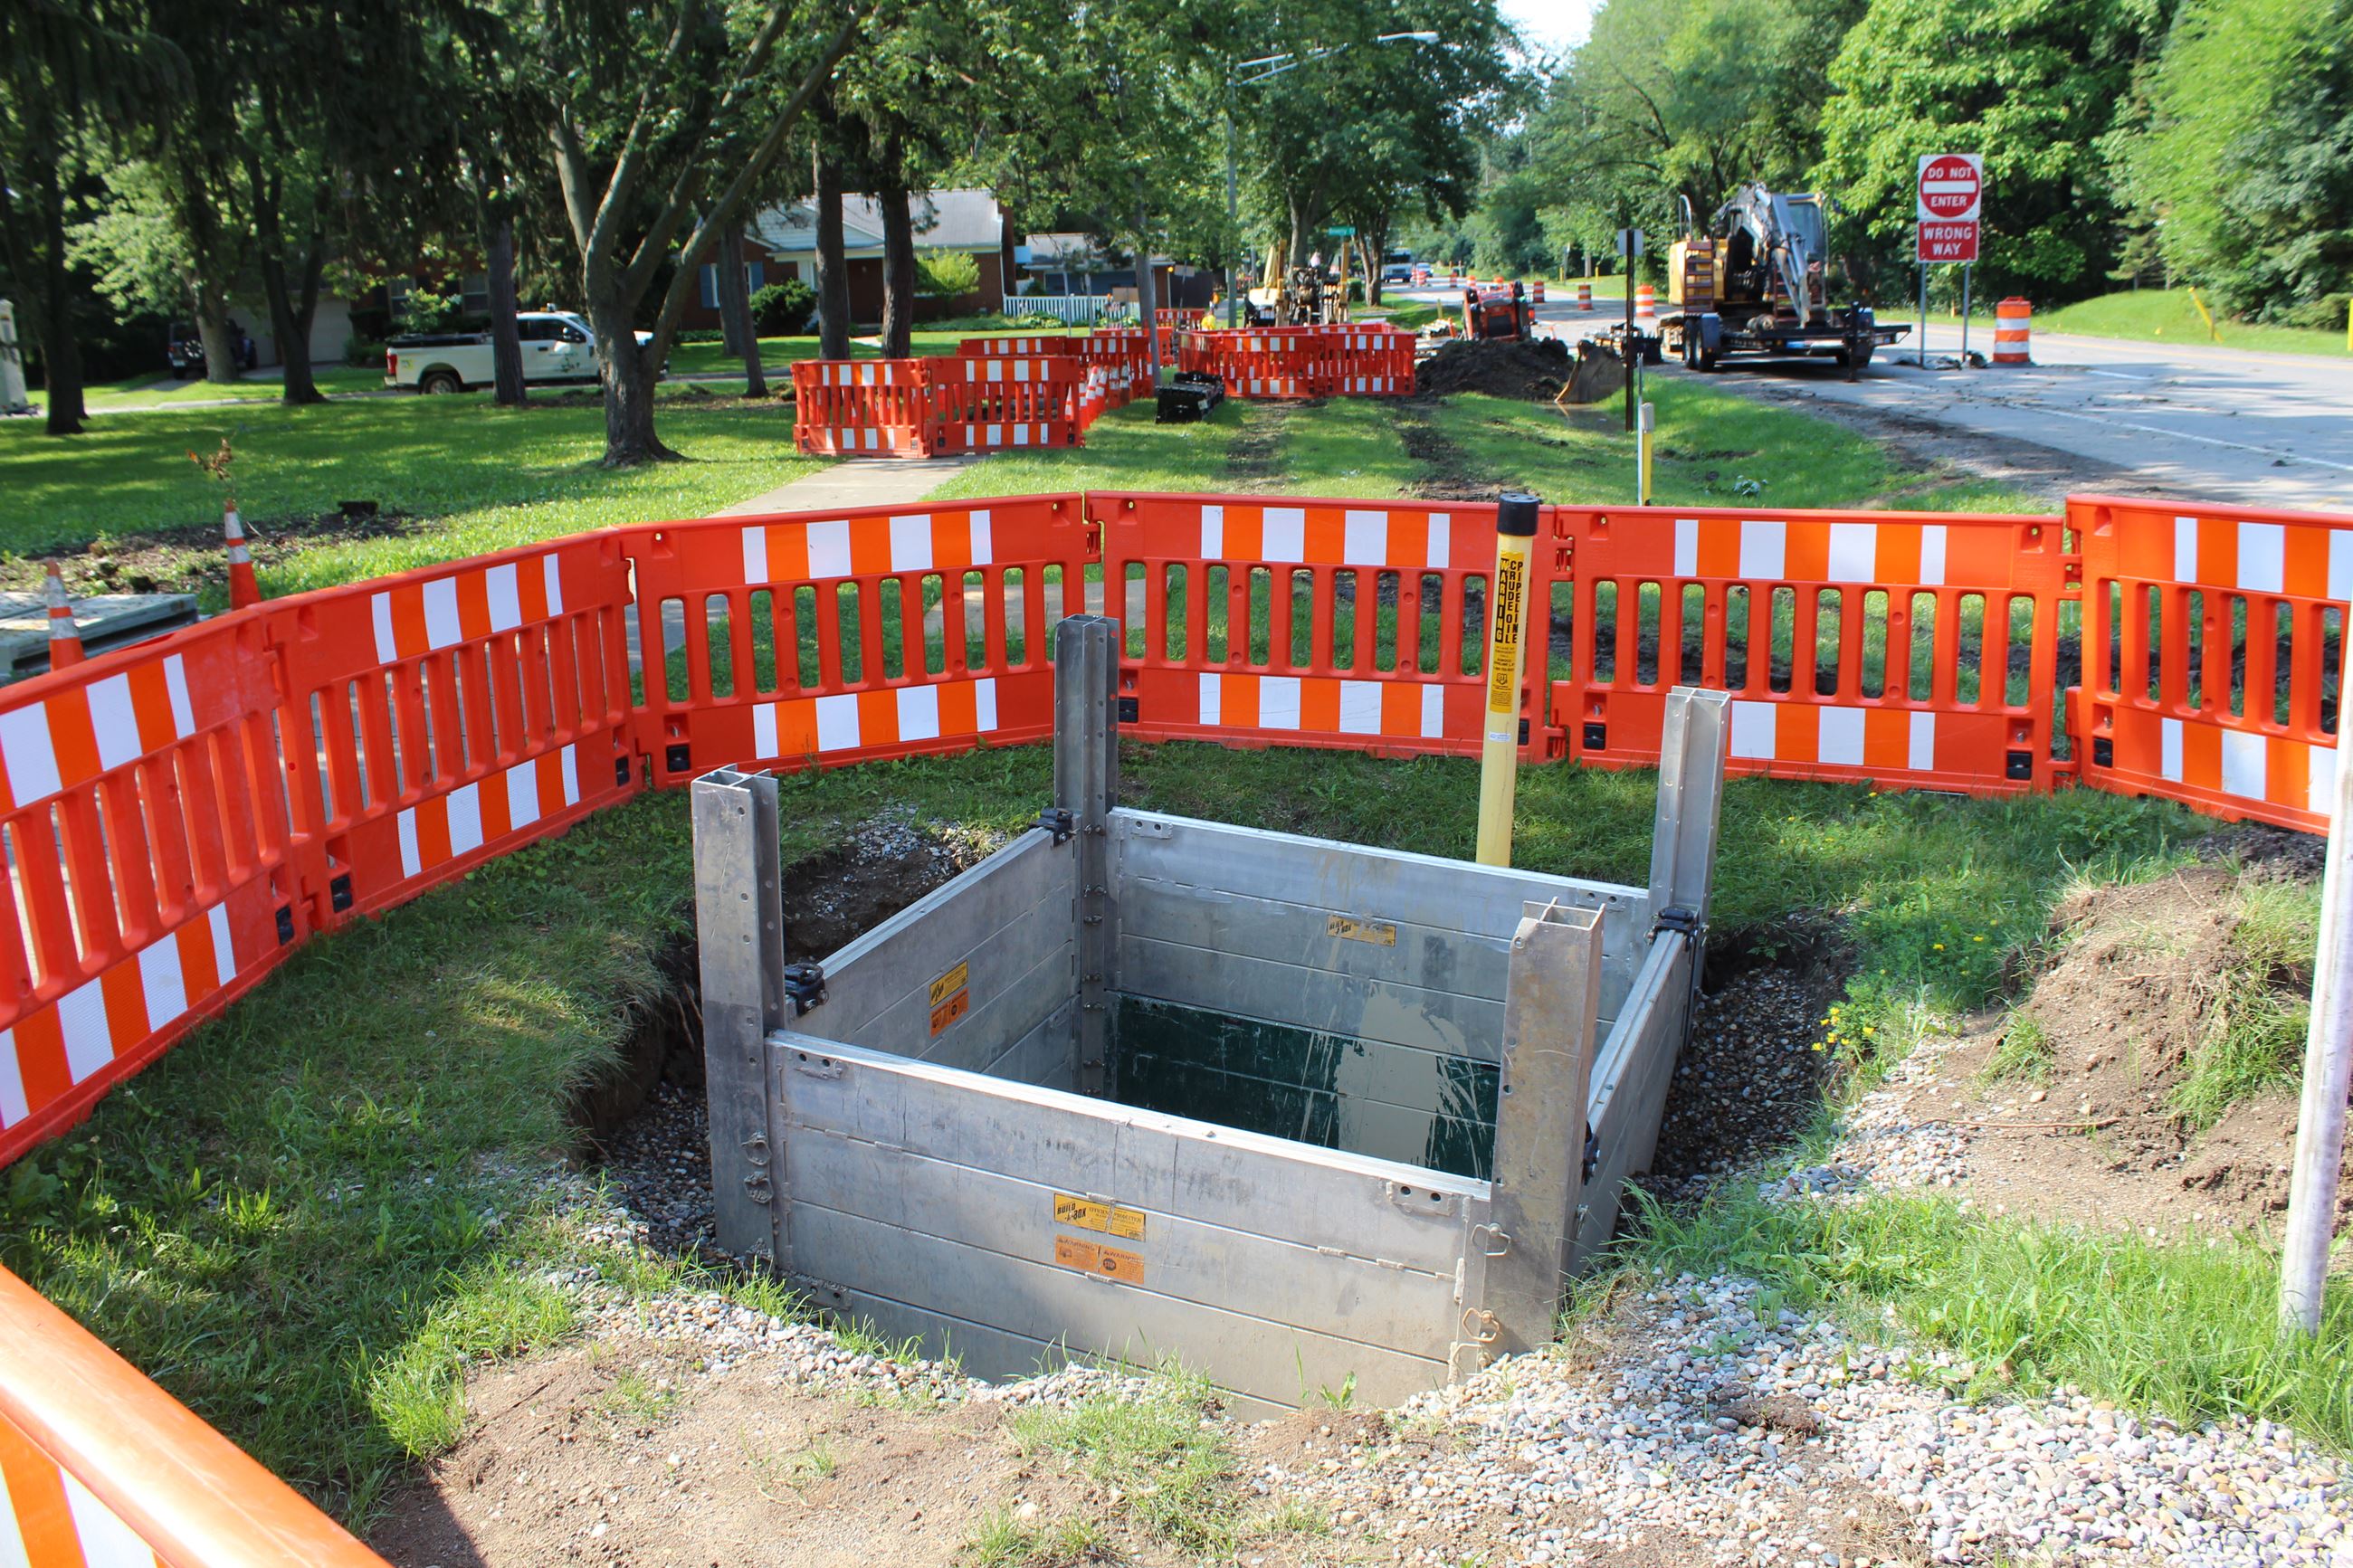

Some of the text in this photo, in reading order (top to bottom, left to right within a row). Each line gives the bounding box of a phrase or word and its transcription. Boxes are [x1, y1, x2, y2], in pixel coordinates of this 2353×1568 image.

[1928, 166, 1973, 179] DO NOT
[1930, 195, 1967, 207] ENTER
[1924, 227, 1972, 240] WRONG
[1932, 242, 1961, 255] WAY
[1508, 560, 1517, 611] CRUDE
[1496, 558, 1508, 641] WARNING
[1511, 561, 1523, 643] PIPELINE
